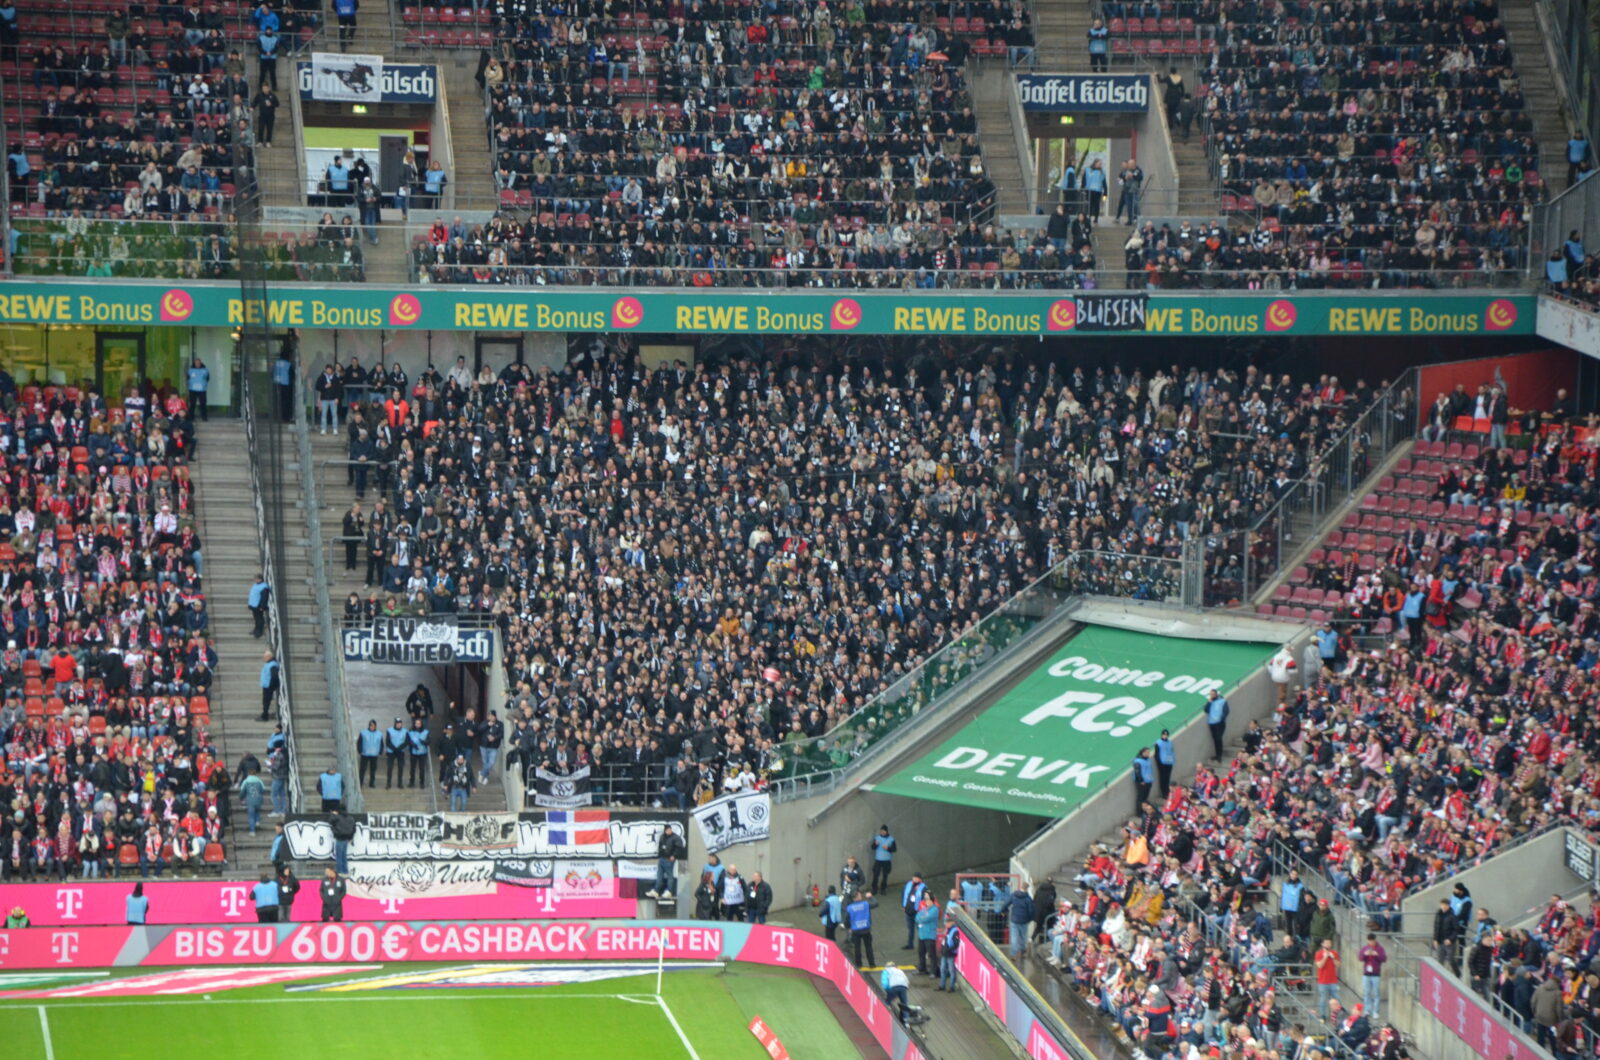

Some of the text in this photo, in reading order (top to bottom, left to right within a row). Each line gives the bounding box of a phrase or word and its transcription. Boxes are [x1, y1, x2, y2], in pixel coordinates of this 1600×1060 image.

[382, 70, 434, 98] ölsch
[1018, 79, 1147, 107] Gaffel Kölsch
[80, 297, 152, 323] Bonus
[228, 299, 382, 326] REWE Bonus
[455, 303, 605, 329] REWE Bonus
[676, 305, 823, 330] REWE Bonus
[894, 307, 1041, 331] REWE Bonus
[1145, 308, 1258, 332] WE Bonus
[1329, 308, 1478, 331] REWE Bonus
[373, 618, 416, 642] ELV
[371, 642, 456, 664] UNITED
[1048, 656, 1225, 696] Come on
[1019, 690, 1177, 738] FC!
[933, 746, 1111, 789] DEVK
[370, 815, 425, 829] JUGEND
[370, 829, 426, 842] KOLLEKTIV
[437, 863, 494, 888] Unity
[56, 888, 83, 918] T
[220, 886, 246, 916] T
[51, 931, 79, 963] T
[175, 930, 225, 957] BIS
[233, 929, 274, 956] ZU
[420, 925, 588, 954] CASHBACK
[596, 926, 721, 953] ERHALTEN
[771, 930, 794, 963] T
[815, 940, 829, 974] T
